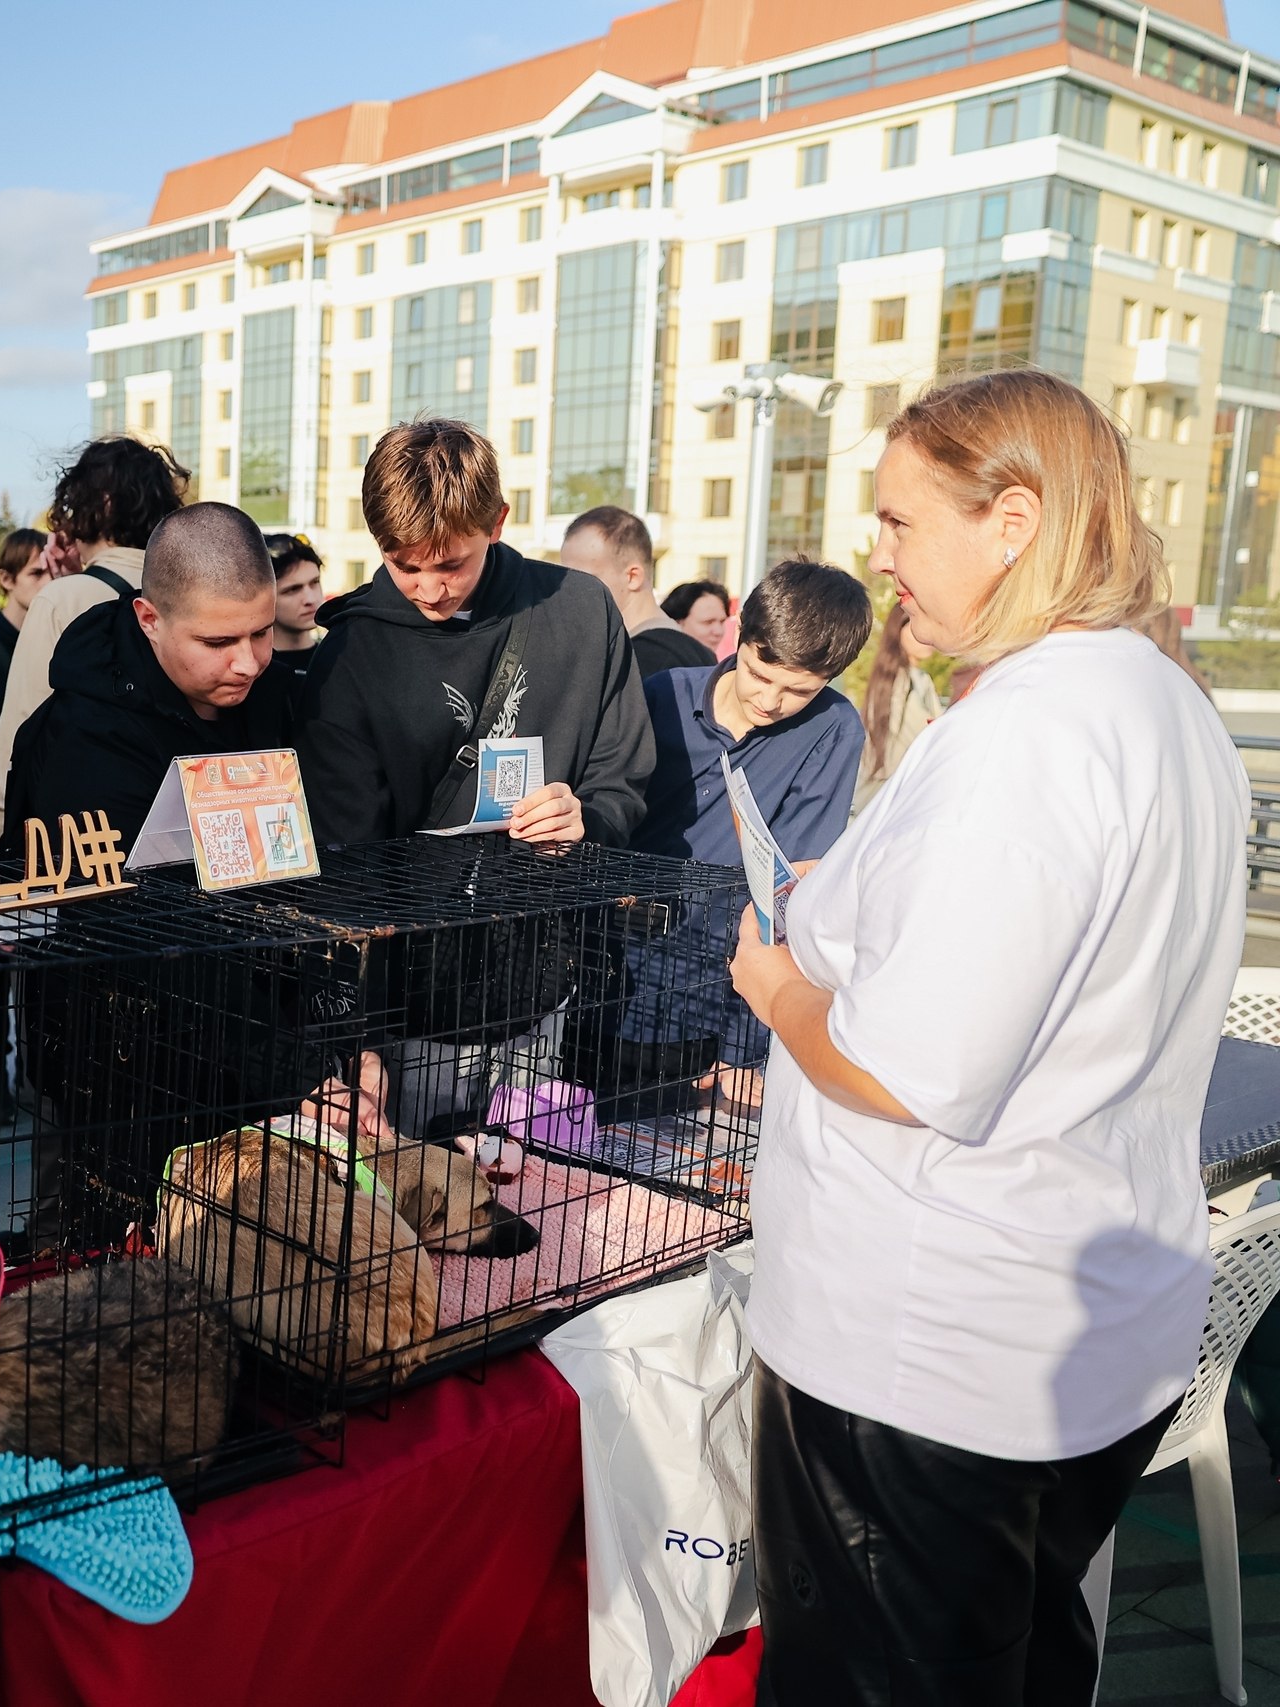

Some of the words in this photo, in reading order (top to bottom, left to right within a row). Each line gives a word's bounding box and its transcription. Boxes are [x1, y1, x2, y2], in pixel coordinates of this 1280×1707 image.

[196, 788, 237, 799] Общественная
[191, 799, 231, 809] безнадзорных
[231, 797, 258, 805] животных
